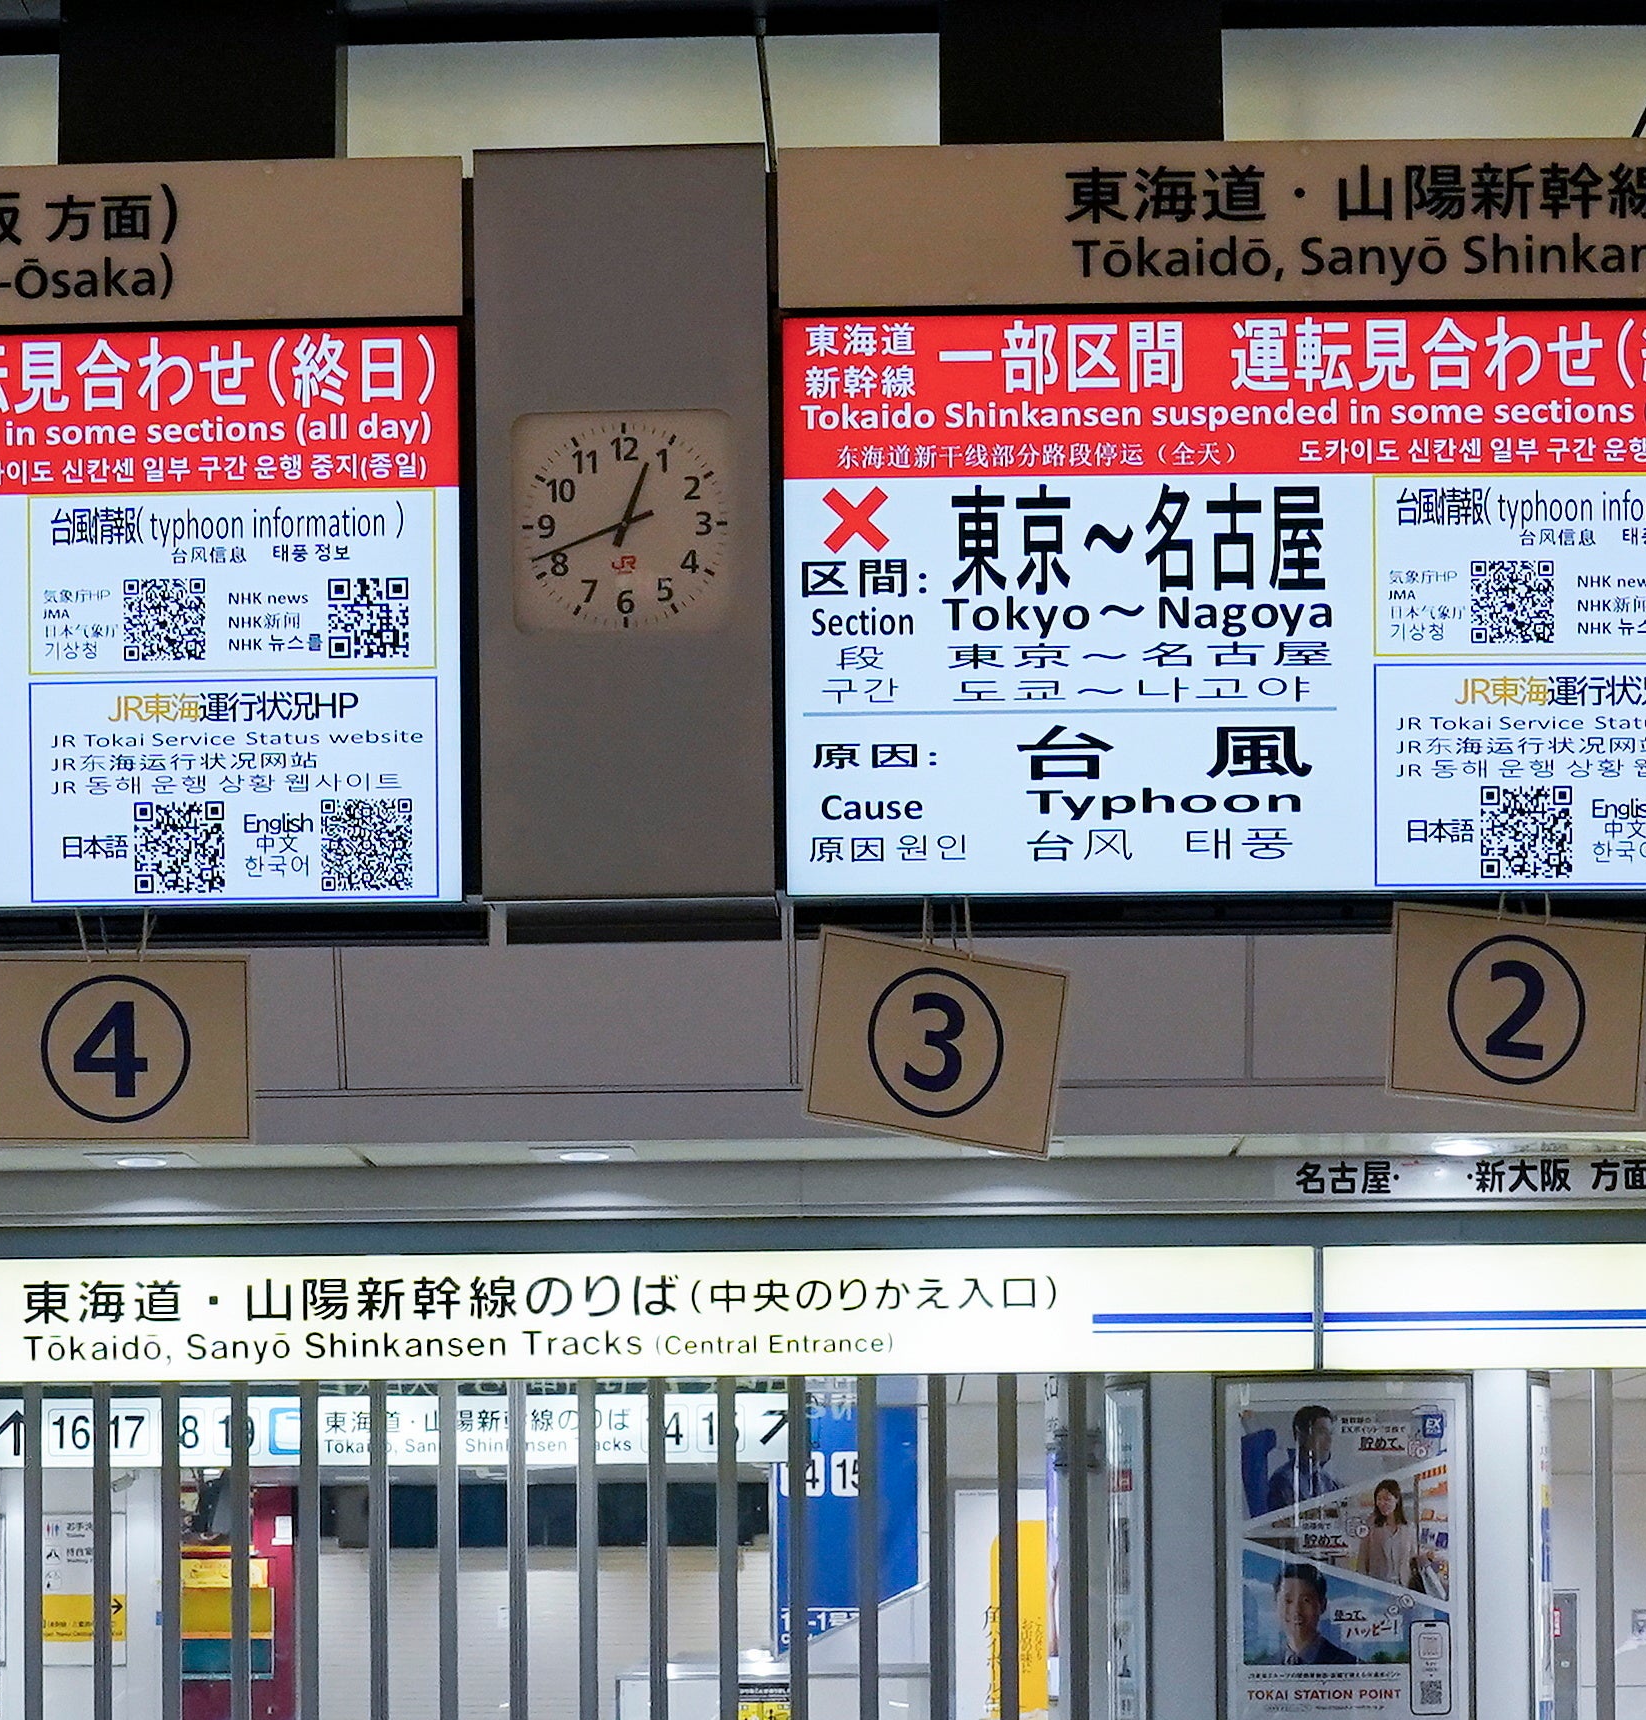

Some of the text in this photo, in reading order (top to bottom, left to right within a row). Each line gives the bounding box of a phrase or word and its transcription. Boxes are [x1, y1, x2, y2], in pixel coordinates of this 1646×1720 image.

[1069, 233, 1288, 282] Tōkaidō,
[1298, 233, 1450, 286] Sanyō
[571, 448, 668, 475] 11 1
[610, 436, 639, 461] 12
[546, 475, 701, 503] 10 2
[537, 511, 712, 539] 9 3
[550, 549, 700, 577] 8 4
[580, 577, 674, 603] 7 5
[1387, 589, 1417, 602] JMA
[1576, 574, 1614, 590] NHK
[616, 589, 635, 614] 6
[1395, 716, 1423, 732] JR
[1429, 715, 1493, 732] Tokai
[1498, 715, 1586, 732] Service
[1405, 817, 1475, 845] 日本語
[1483, 957, 1548, 1066] 2
[67, 995, 153, 1102] 4
[898, 990, 969, 1097] 3
[20, 1327, 896, 1367] Tōkaidō, Sanyō Shinkansen Tracks (Central Entrance)
[52, 1415, 91, 1449] 16
[110, 1415, 145, 1448] 17
[1246, 1686, 1403, 1702] TOKAI STATION POINT
